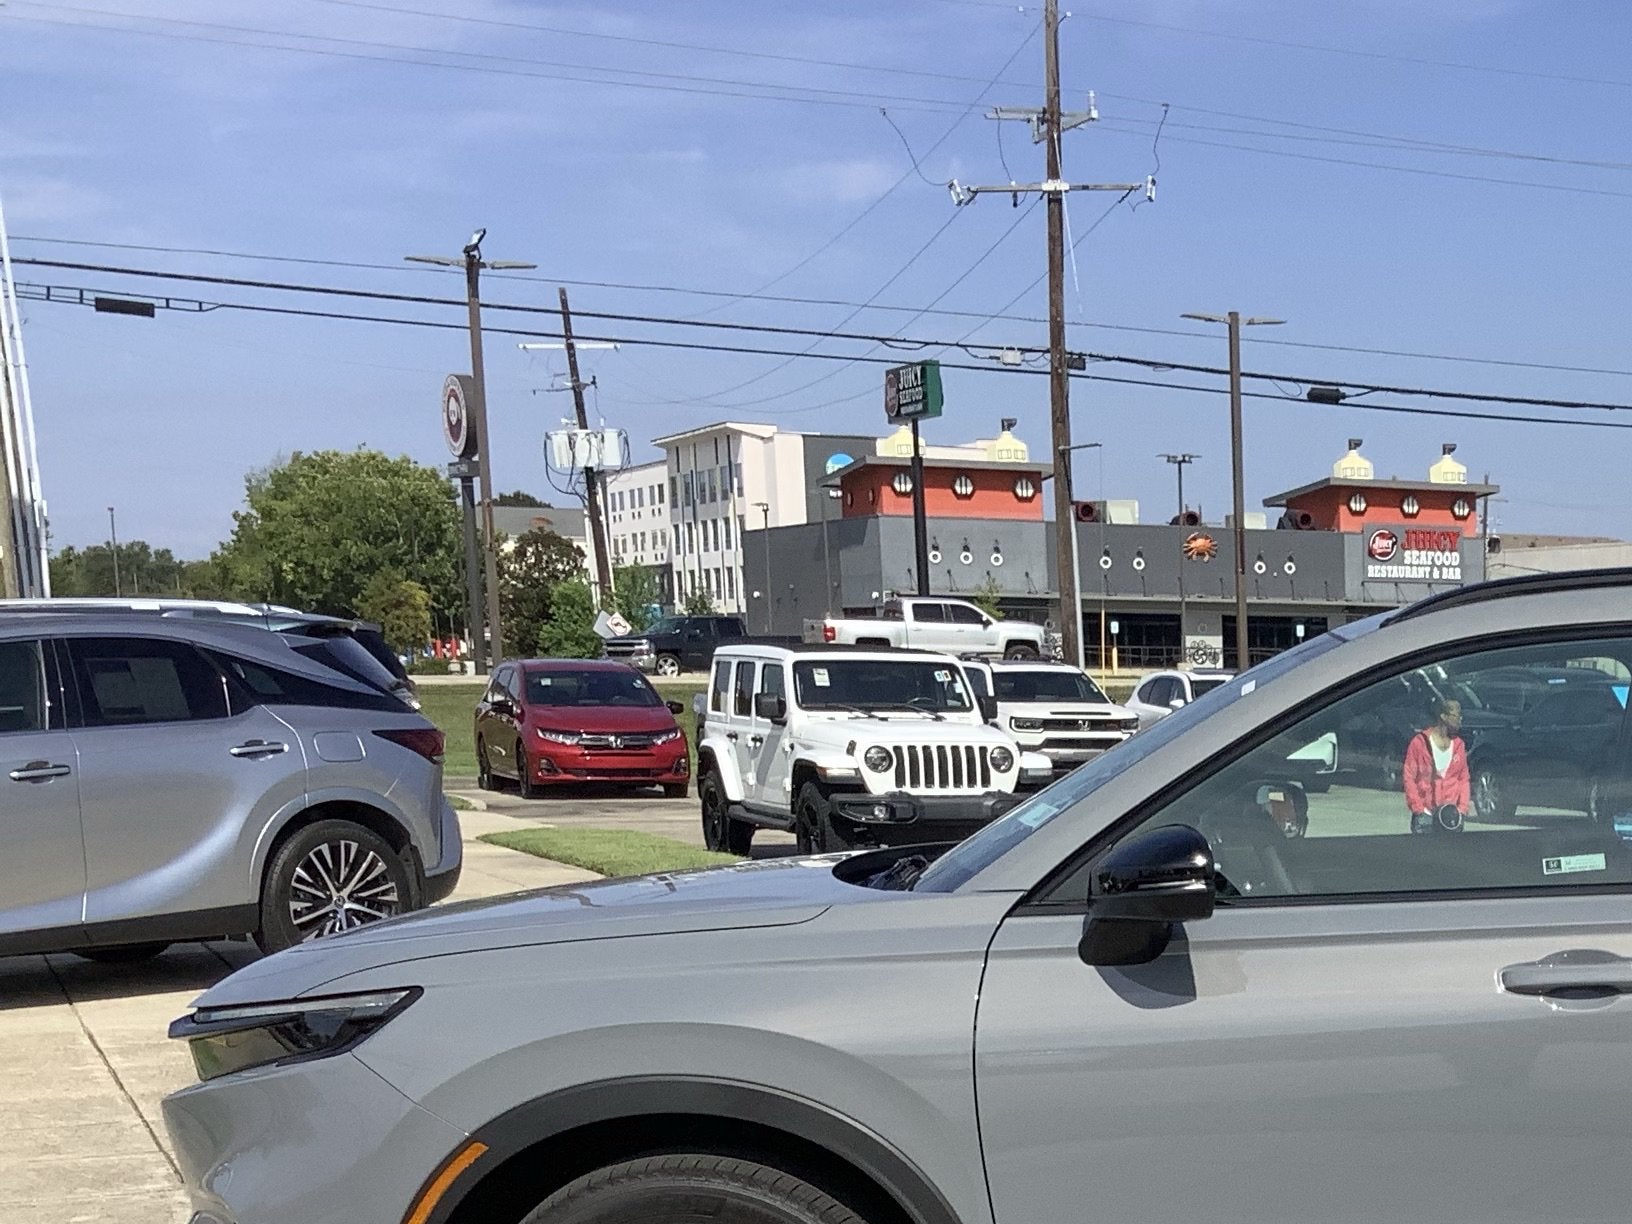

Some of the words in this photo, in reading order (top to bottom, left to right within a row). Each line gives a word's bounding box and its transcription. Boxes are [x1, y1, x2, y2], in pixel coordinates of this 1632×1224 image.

[899, 365, 922, 391] JUICY
[1400, 529, 1460, 552] JUICY
[1403, 550, 1460, 566] SEAFOOD
[1367, 564, 1430, 578] RESTAURANT
[1432, 566, 1440, 579] &
[1441, 567, 1461, 580] BAR
